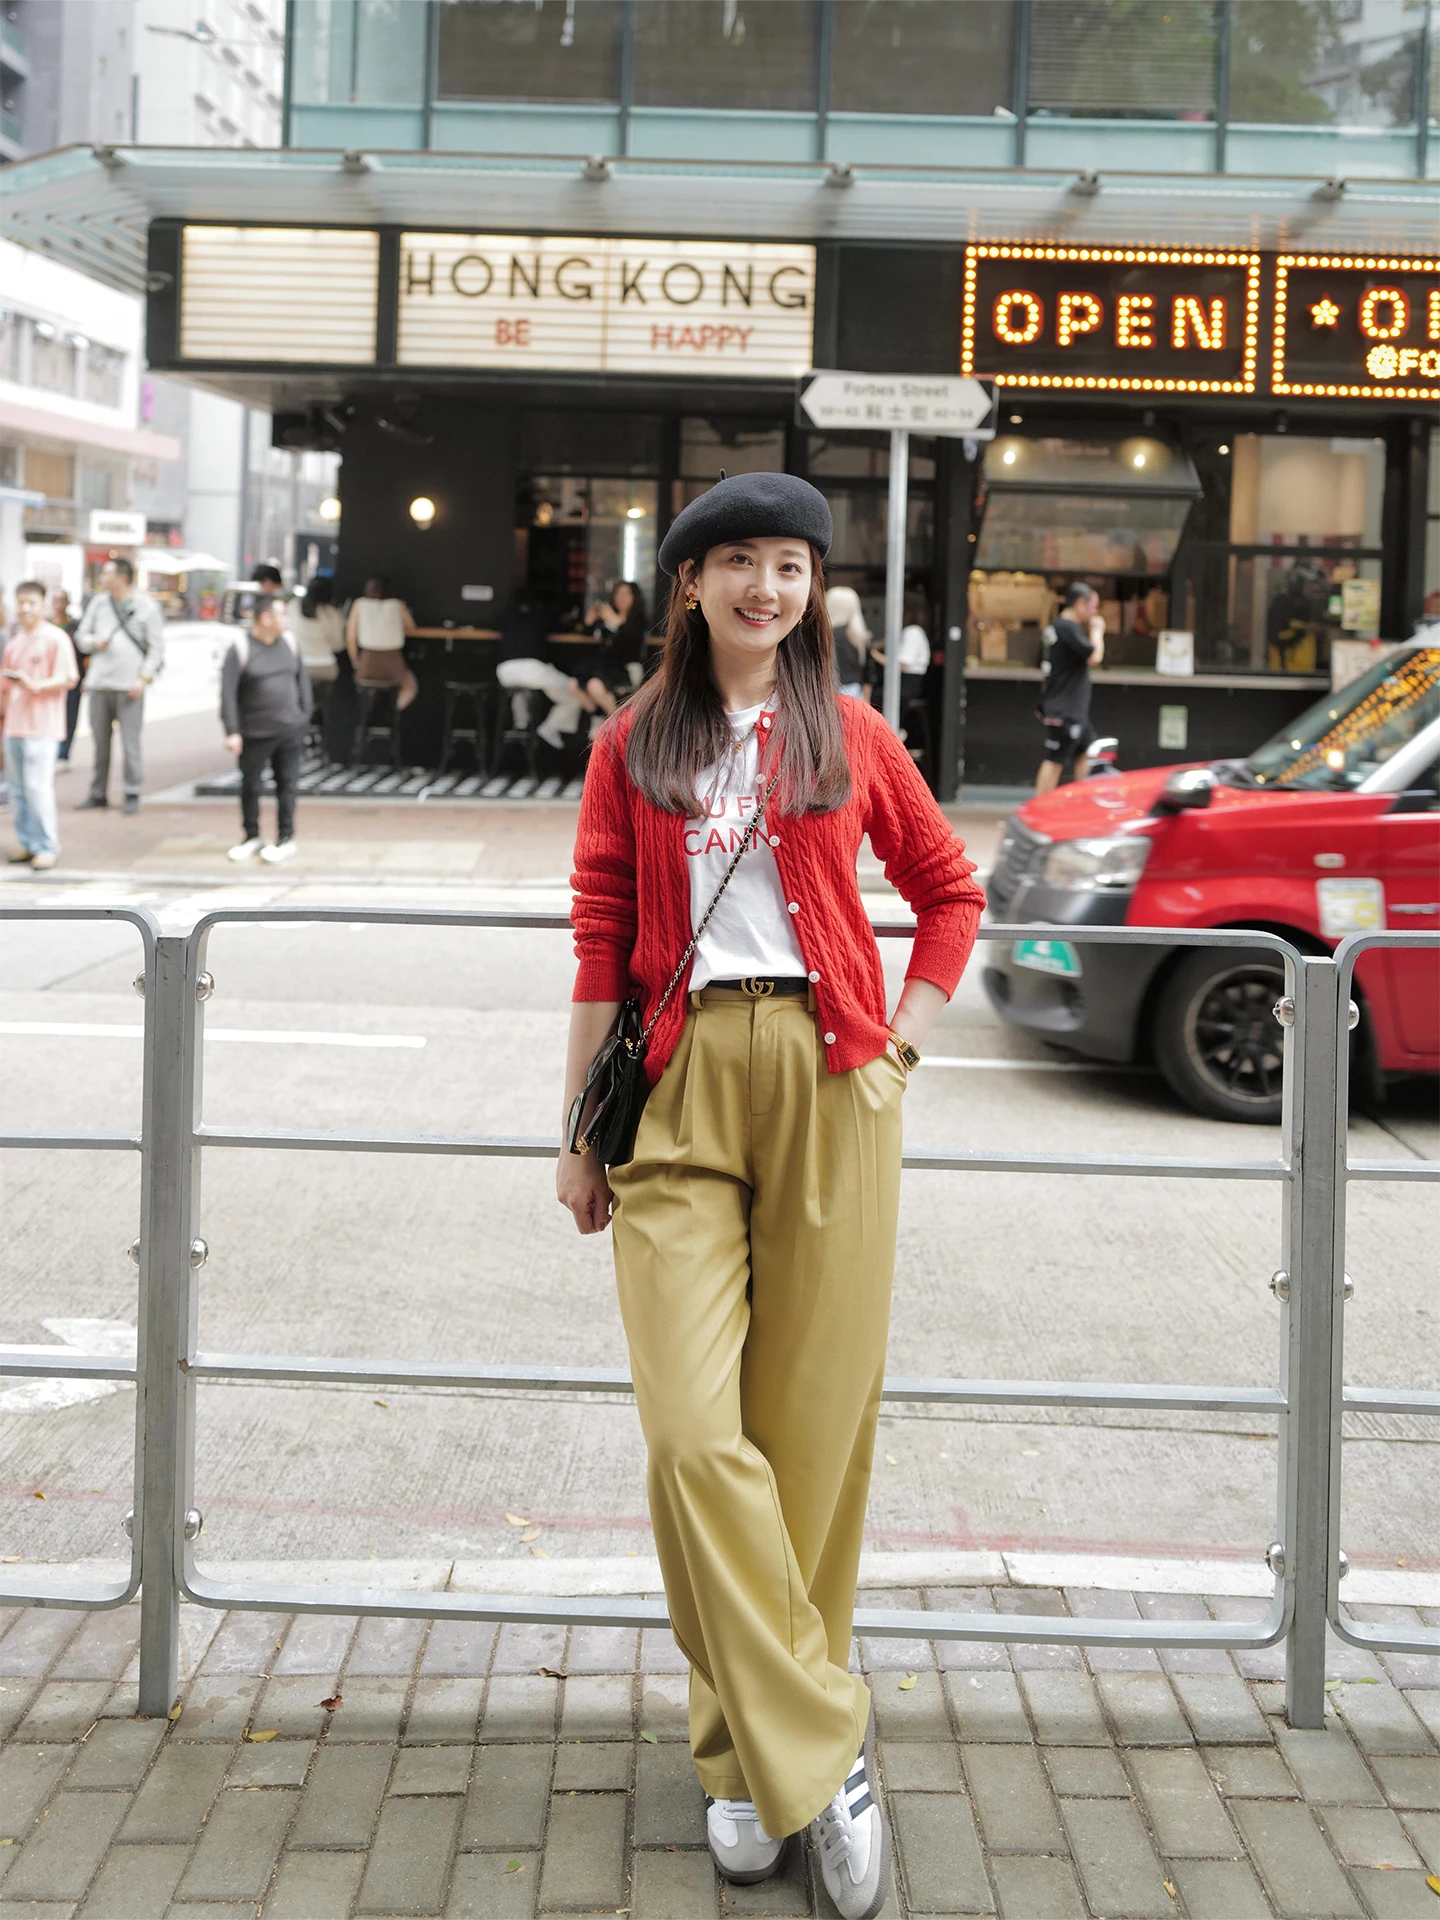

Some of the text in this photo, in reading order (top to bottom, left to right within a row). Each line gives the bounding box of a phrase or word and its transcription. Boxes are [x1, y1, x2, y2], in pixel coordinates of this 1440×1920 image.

[406, 252, 807, 309] HONG KONG
[495, 318, 756, 352] BE HAPPY
[993, 289, 1226, 349] OPEN
[843, 381, 950, 398] Forbes Street
